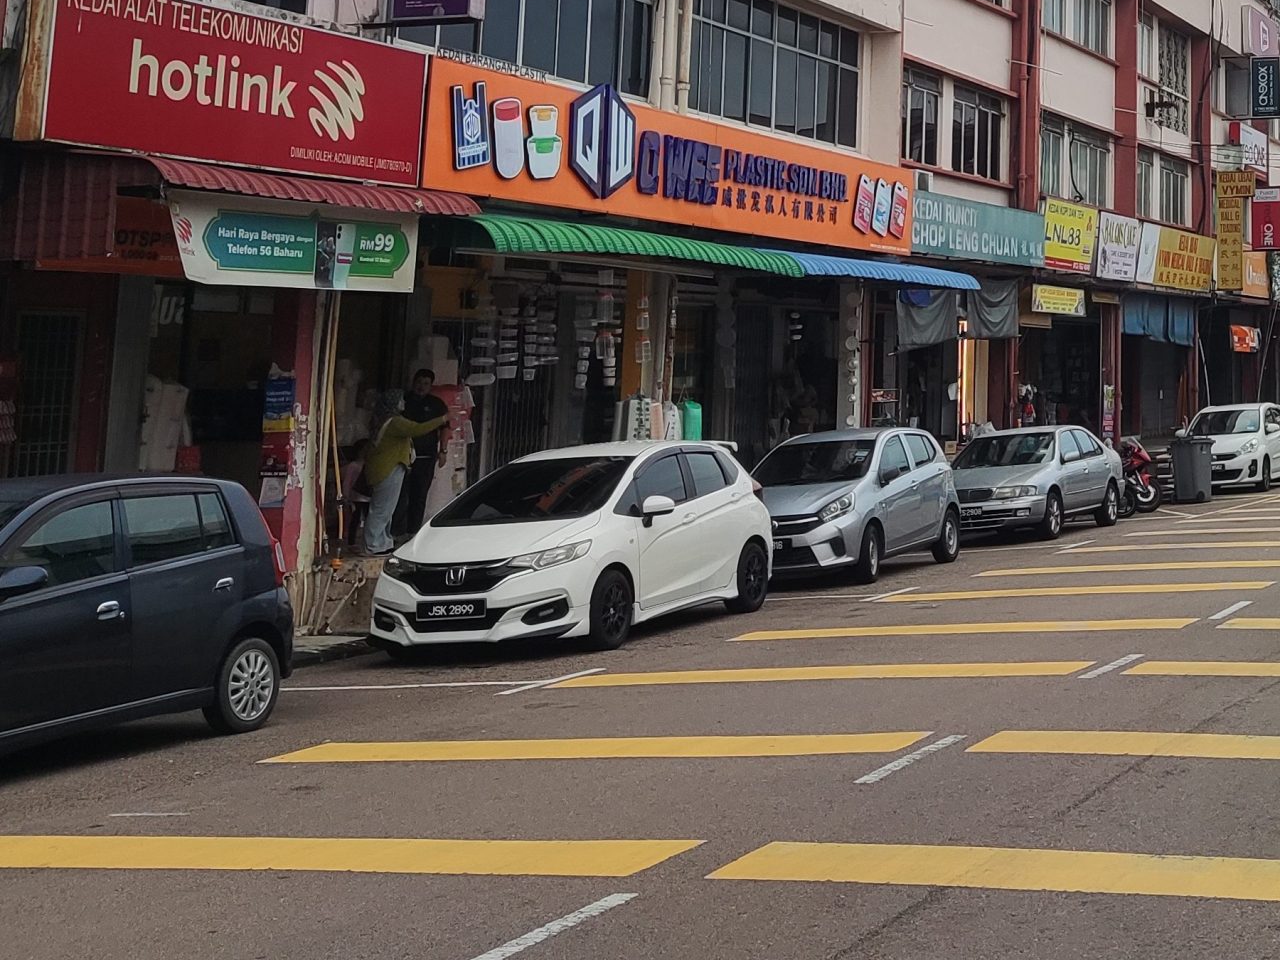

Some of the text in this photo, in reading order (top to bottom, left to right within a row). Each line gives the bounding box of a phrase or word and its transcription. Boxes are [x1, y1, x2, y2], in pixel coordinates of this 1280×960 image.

[171, 2, 305, 54] TELEKOMUNIKASI
[437, 48, 549, 84] KEDAI BARANGAN PLASTIK
[128, 38, 298, 119] hotlink
[290, 146, 315, 159] DIMILIKI
[334, 153, 352, 166] ACOM
[352, 155, 374, 168] MOBILE
[724, 149, 788, 191] PLASTIC
[1222, 185, 1252, 196] VYMIN
[912, 197, 943, 222] KEDAI
[218, 227, 237, 238] Hari
[238, 229, 259, 241] Raya
[261, 230, 295, 243] Bergaya
[360, 233, 395, 252] RM99
[912, 222, 946, 247] CHOP
[949, 227, 980, 253] LENG
[981, 232, 1019, 258] CHUAN
[227, 243, 303, 258] Telefon 5G Baharu
[427, 603, 475, 618] JSK 2899
